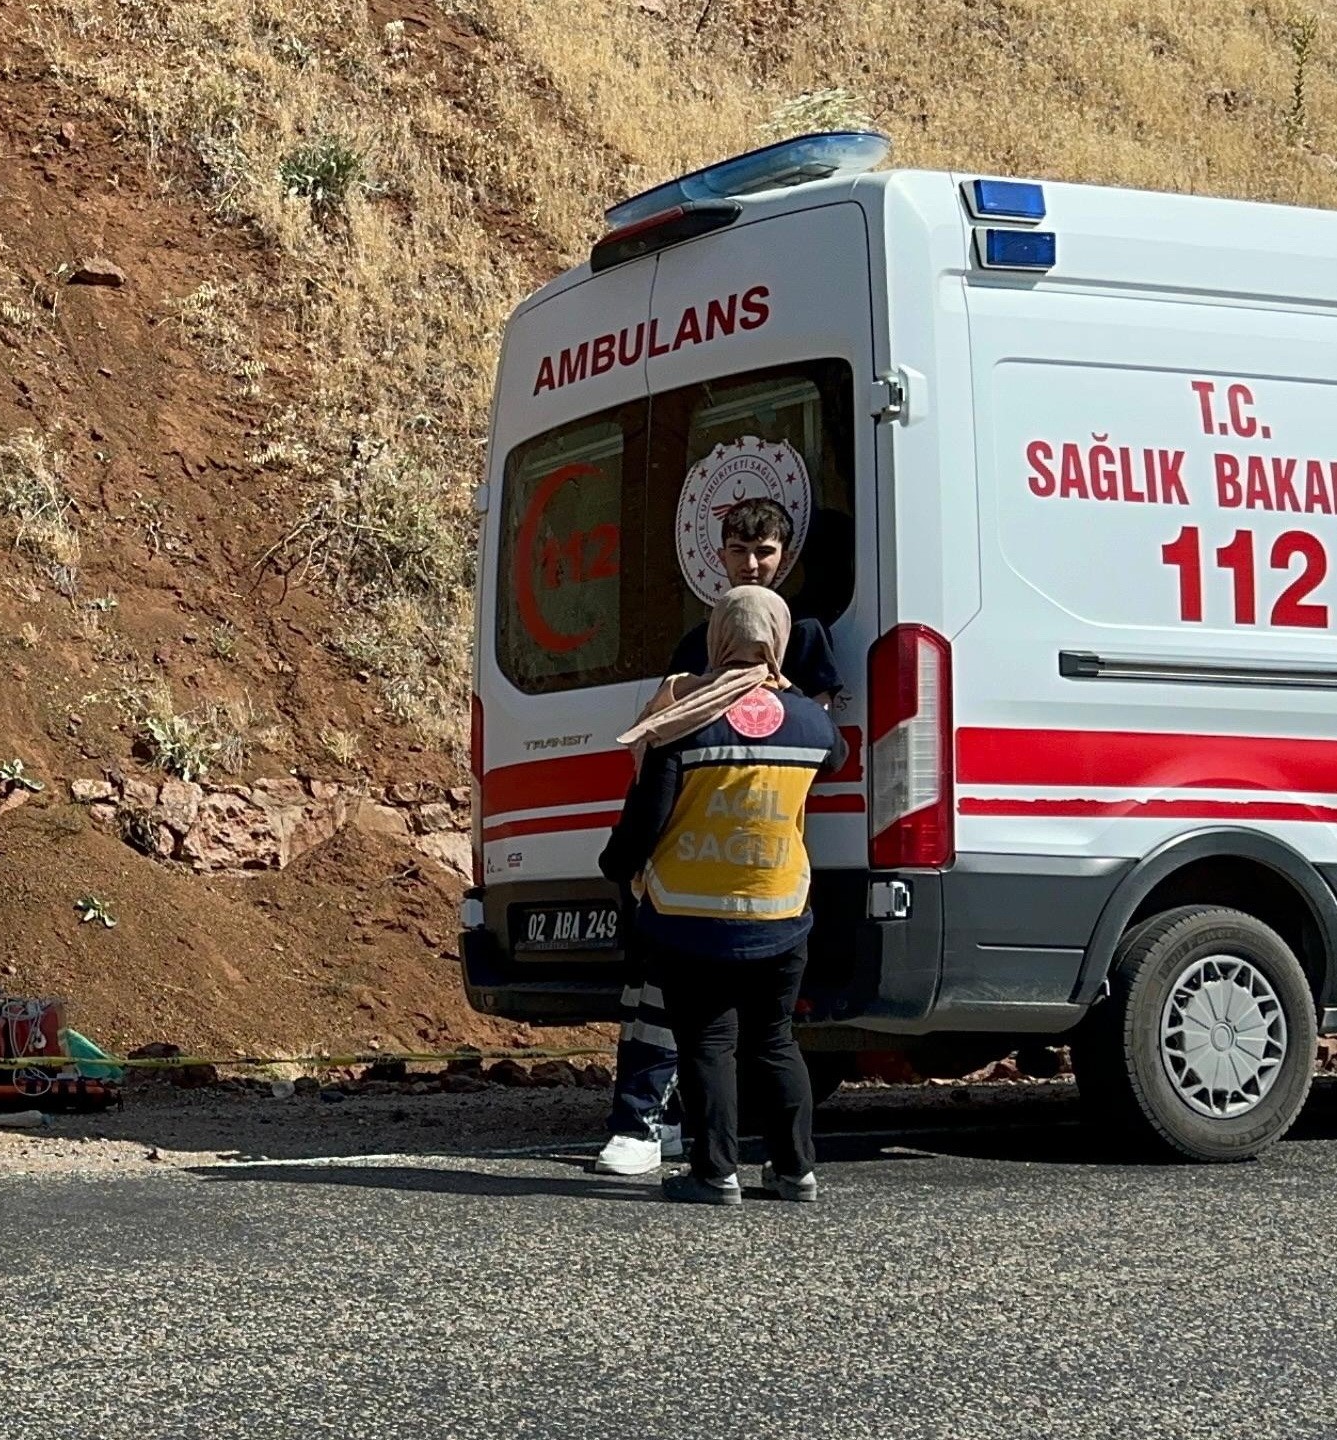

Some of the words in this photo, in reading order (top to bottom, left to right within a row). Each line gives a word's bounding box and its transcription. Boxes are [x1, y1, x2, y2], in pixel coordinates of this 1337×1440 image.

[533, 285, 770, 397] AMBULANS
[1191, 380, 1271, 439] T.C.
[749, 460, 778, 491] SAĞLIK
[1026, 431, 1190, 506] SAĞLIK
[1214, 453, 1337, 515] BAKA
[540, 522, 621, 591] 112
[1161, 526, 1329, 629] 112
[705, 782, 790, 821] ACİL
[527, 912, 547, 941] 02
[553, 911, 581, 940] ABA
[585, 909, 618, 939] 249
